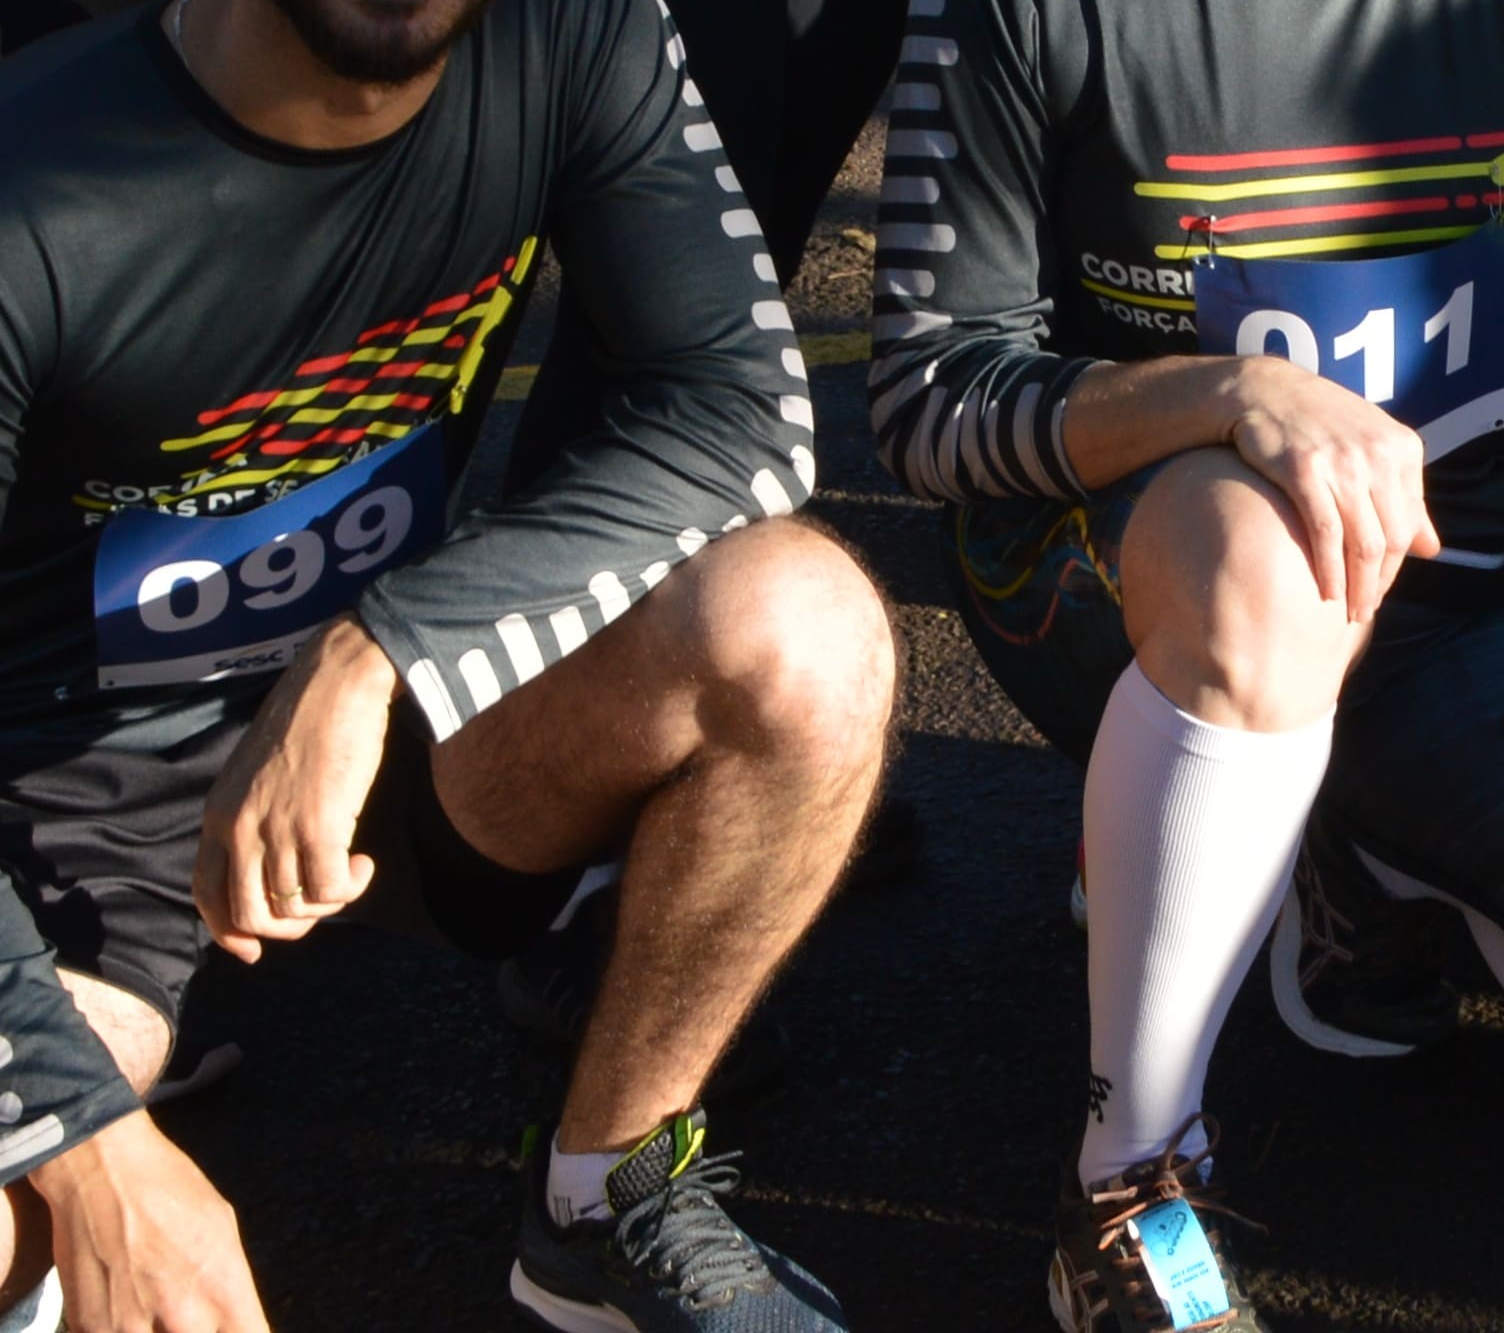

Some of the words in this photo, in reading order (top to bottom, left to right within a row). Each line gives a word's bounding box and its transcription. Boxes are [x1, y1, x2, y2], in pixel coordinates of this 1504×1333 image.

[1081, 252, 1194, 295] CORRI
[1097, 295, 1198, 334] FORÇA
[137, 485, 413, 634] 099
